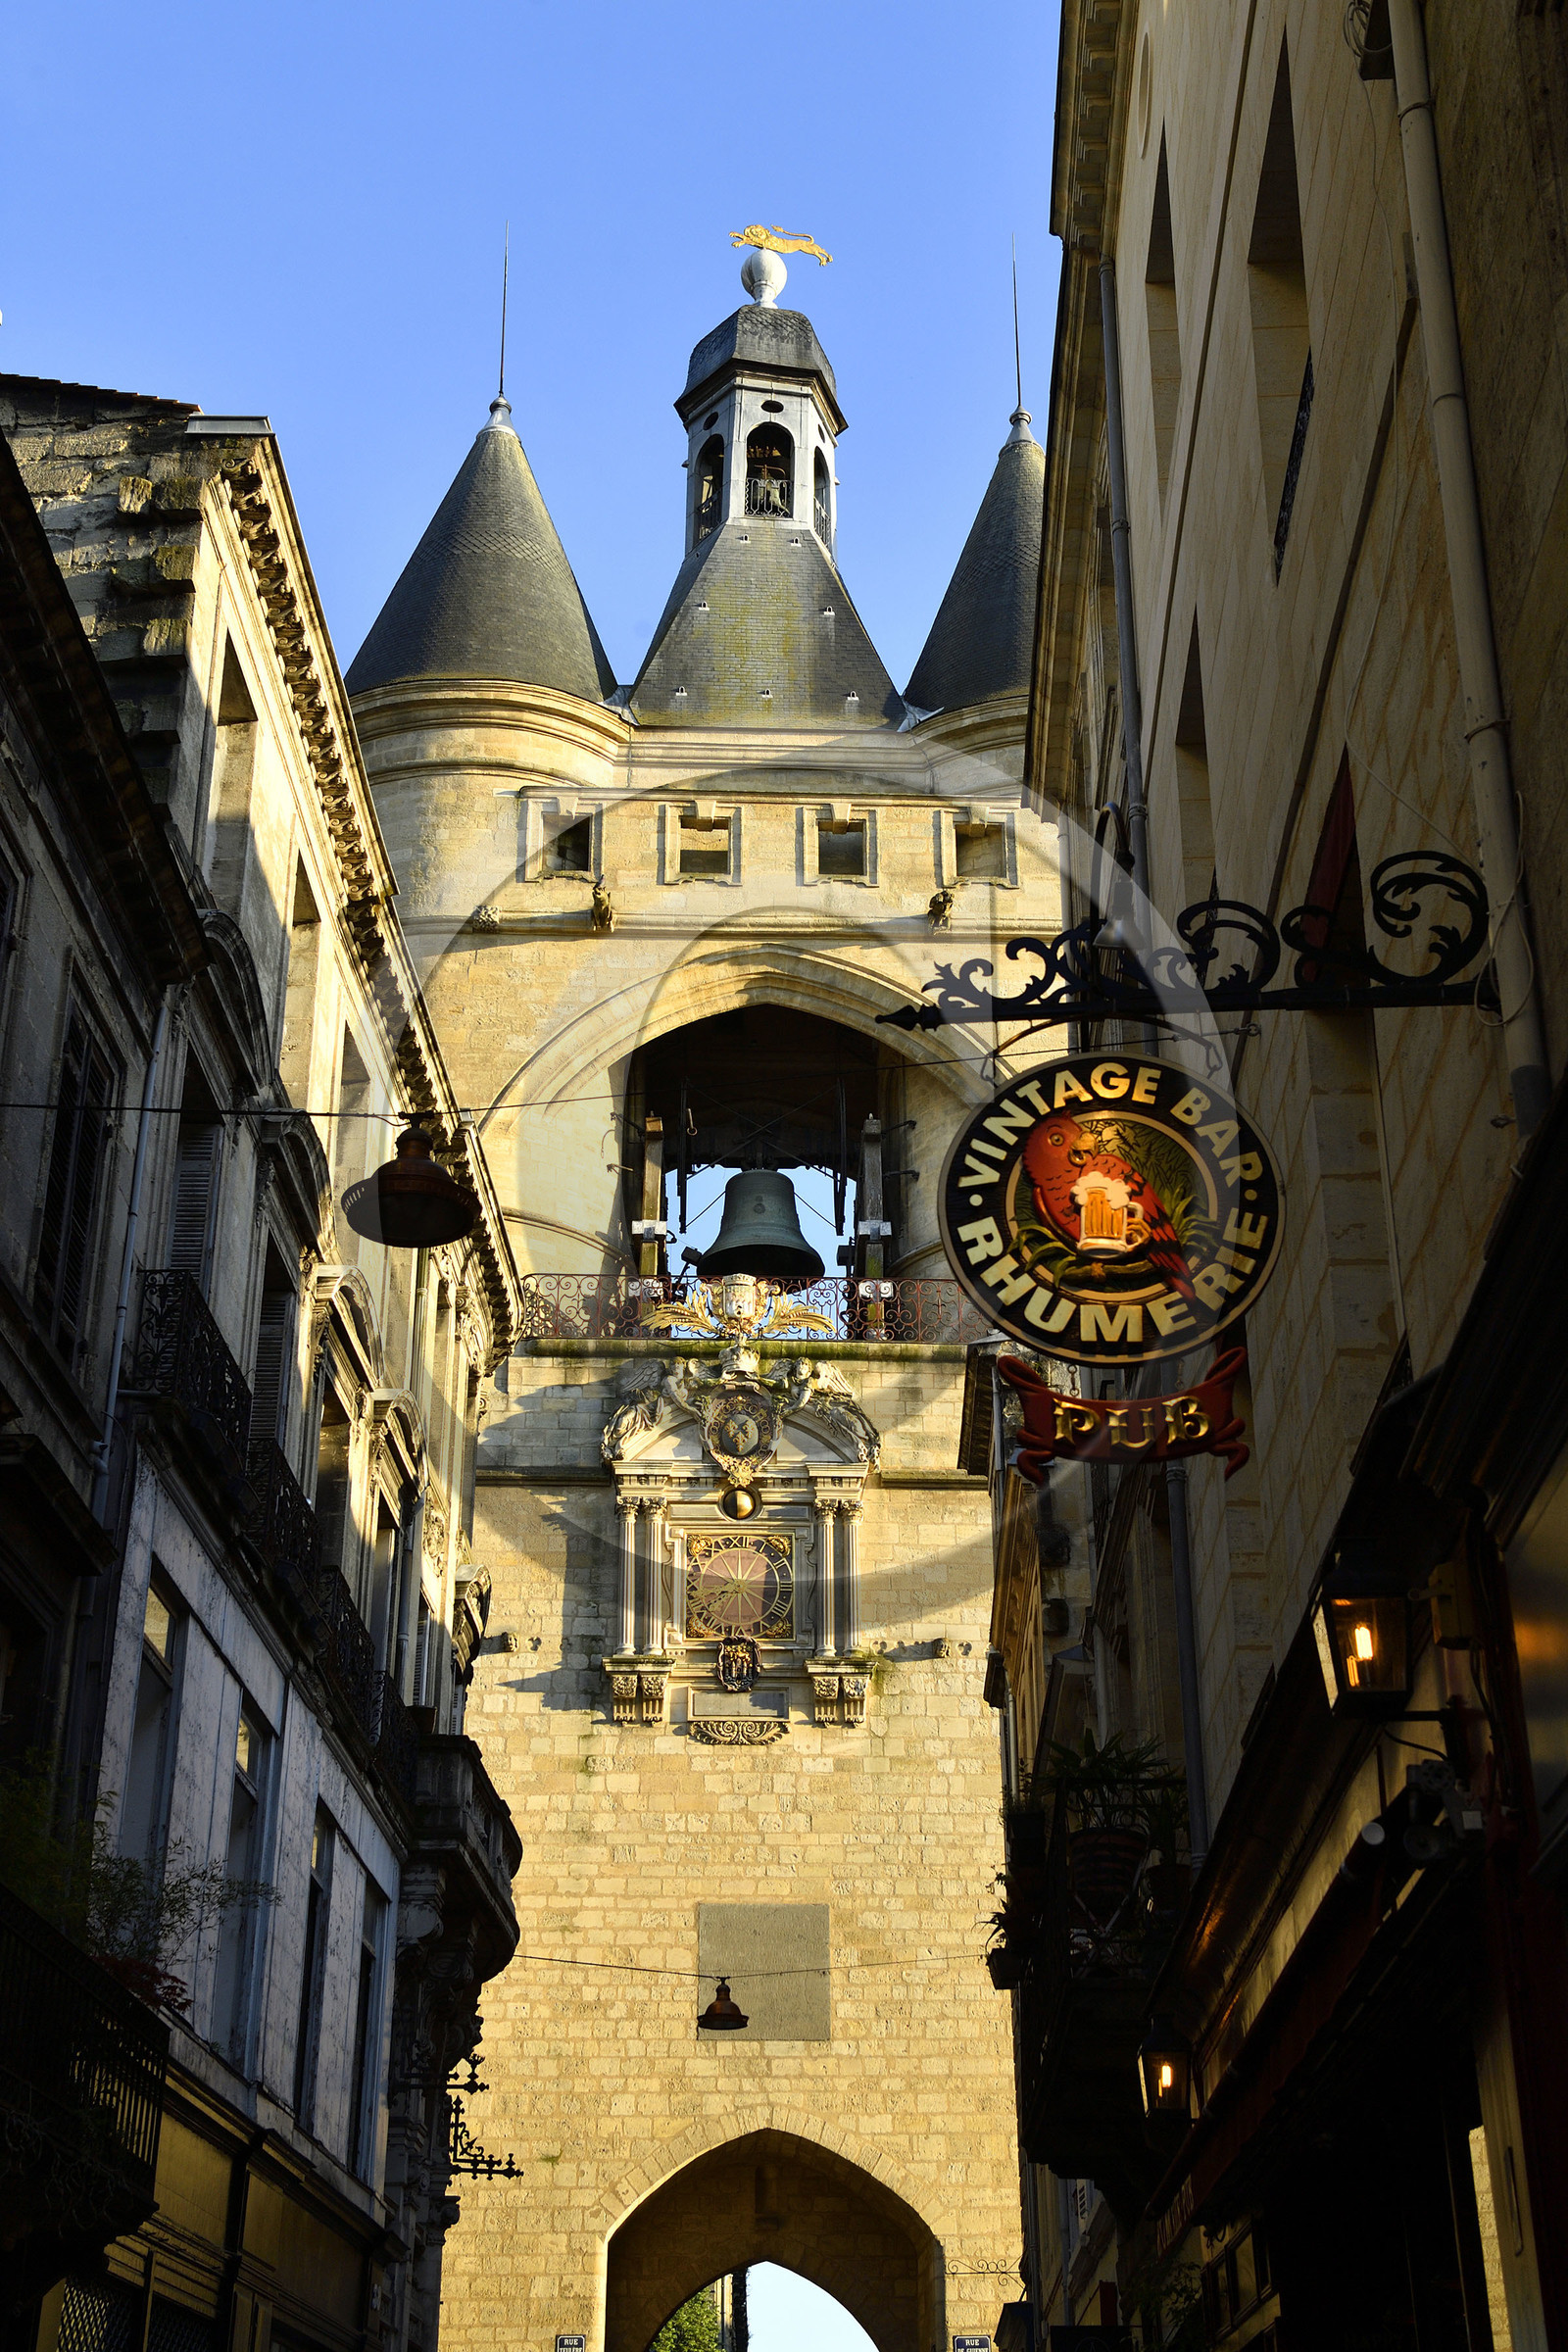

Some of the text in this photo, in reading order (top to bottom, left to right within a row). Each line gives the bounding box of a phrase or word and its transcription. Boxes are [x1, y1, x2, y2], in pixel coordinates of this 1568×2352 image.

[957, 1062, 1263, 1188] VINTAGE BAR
[956, 1206, 1269, 1344] RHUMERIE
[1052, 1395, 1212, 1449] PUB
[729, 1536, 750, 1548] XII
